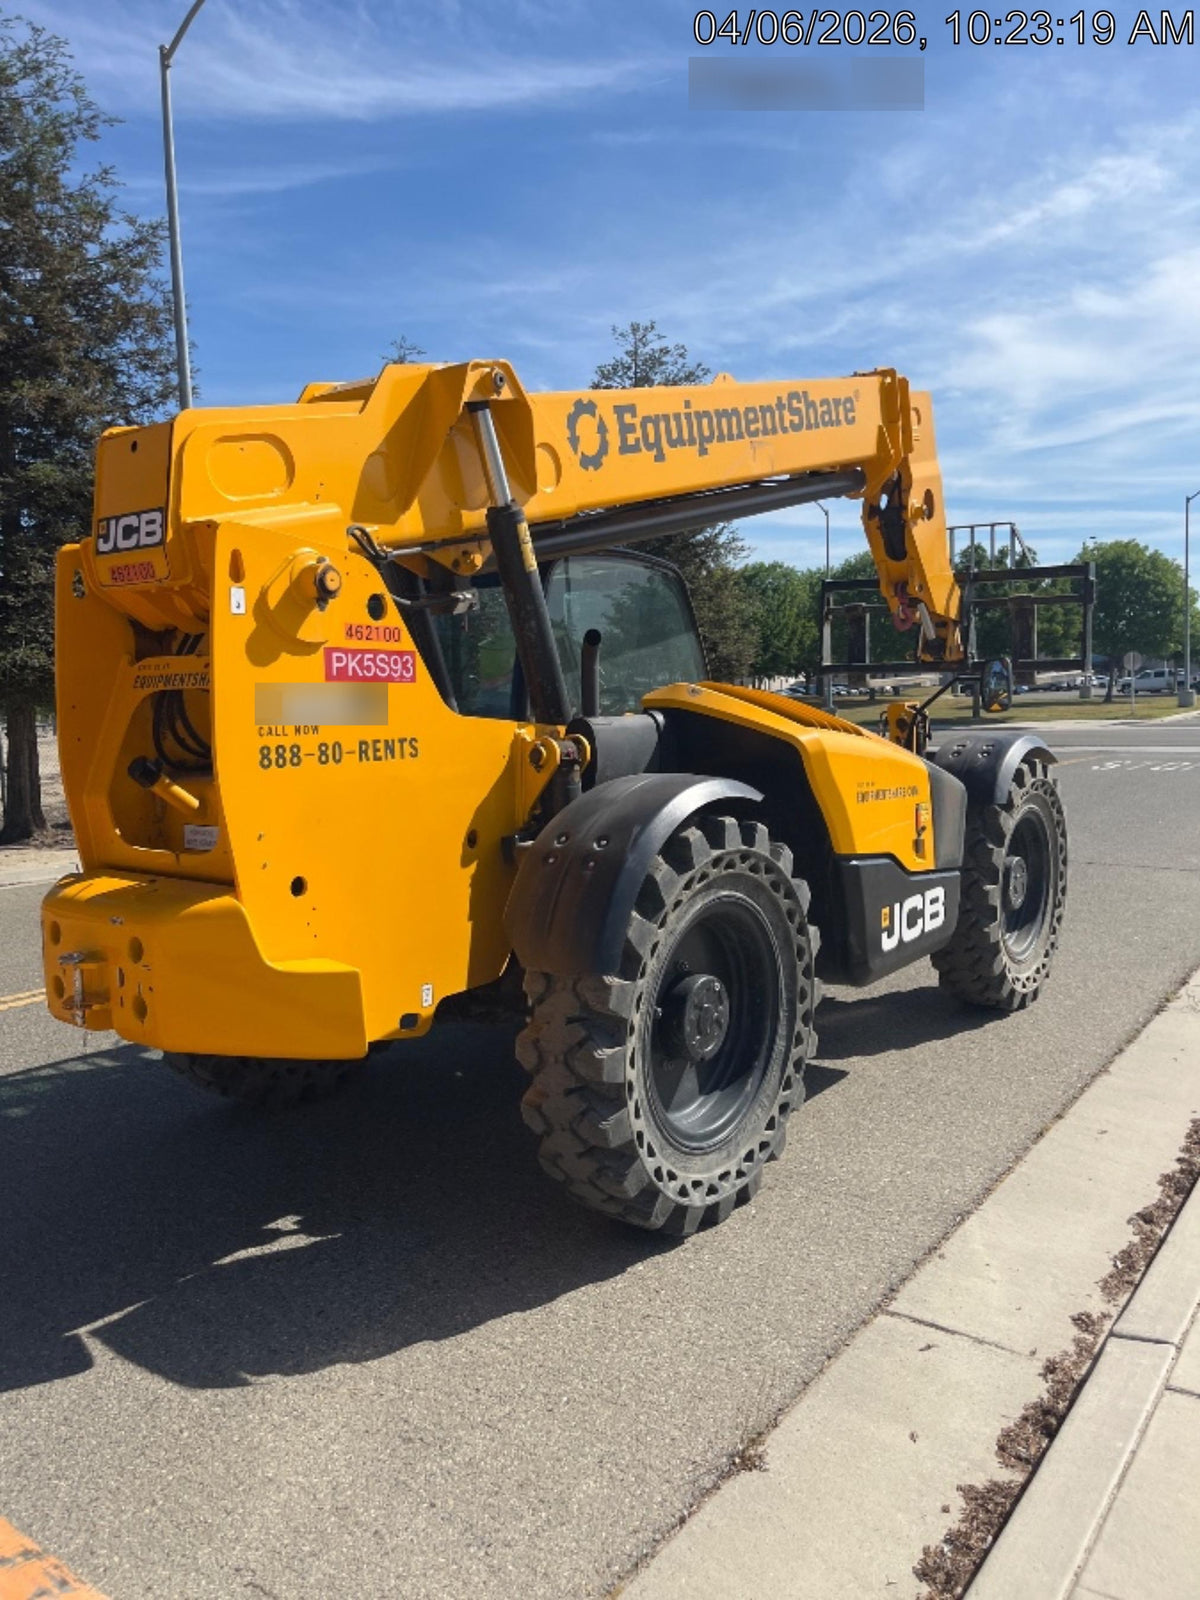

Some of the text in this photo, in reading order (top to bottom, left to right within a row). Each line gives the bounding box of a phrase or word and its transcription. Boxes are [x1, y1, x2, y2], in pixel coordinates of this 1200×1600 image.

[613, 391, 856, 462] EquipmentShare
[97, 511, 163, 552] JCB
[345, 624, 401, 642] 462100
[332, 652, 414, 678] PK5S93
[258, 724, 320, 737] CALL NOW
[258, 737, 419, 770] 888-80-RENTS
[881, 886, 946, 953] JCB
